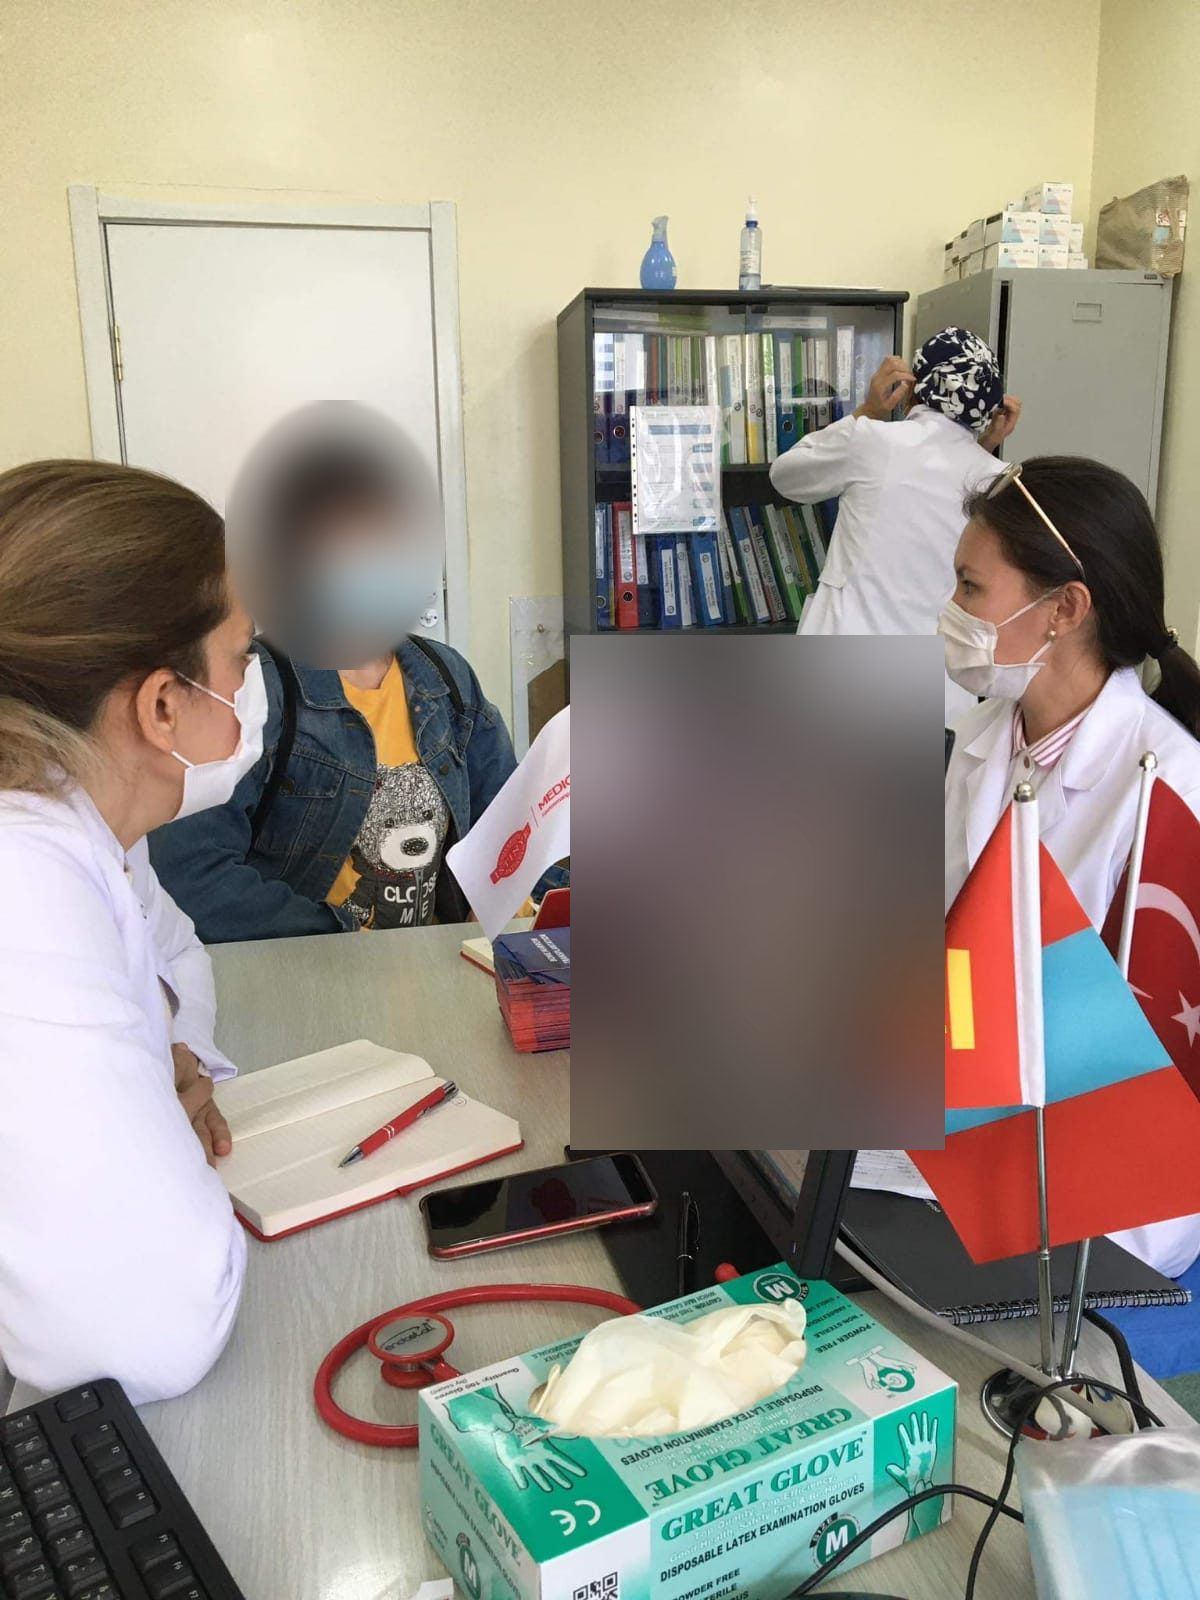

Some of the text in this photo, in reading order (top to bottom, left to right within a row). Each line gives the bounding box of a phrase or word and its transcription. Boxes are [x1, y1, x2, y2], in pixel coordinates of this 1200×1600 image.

[815, 1323, 872, 1353] POWDER FREE
[620, 1384, 824, 1466] DISPOSABLE LATEX EXAMINATION GLOVES
[645, 1407, 853, 1502] GREAT GLOVE
[661, 1437, 864, 1541] GREAT GLOVE
[660, 1482, 866, 1583] DISPOSABLE LATEX EXAMINATION GLOVES
[825, 1524, 849, 1556] M
[715, 1568, 741, 1586] FREE
